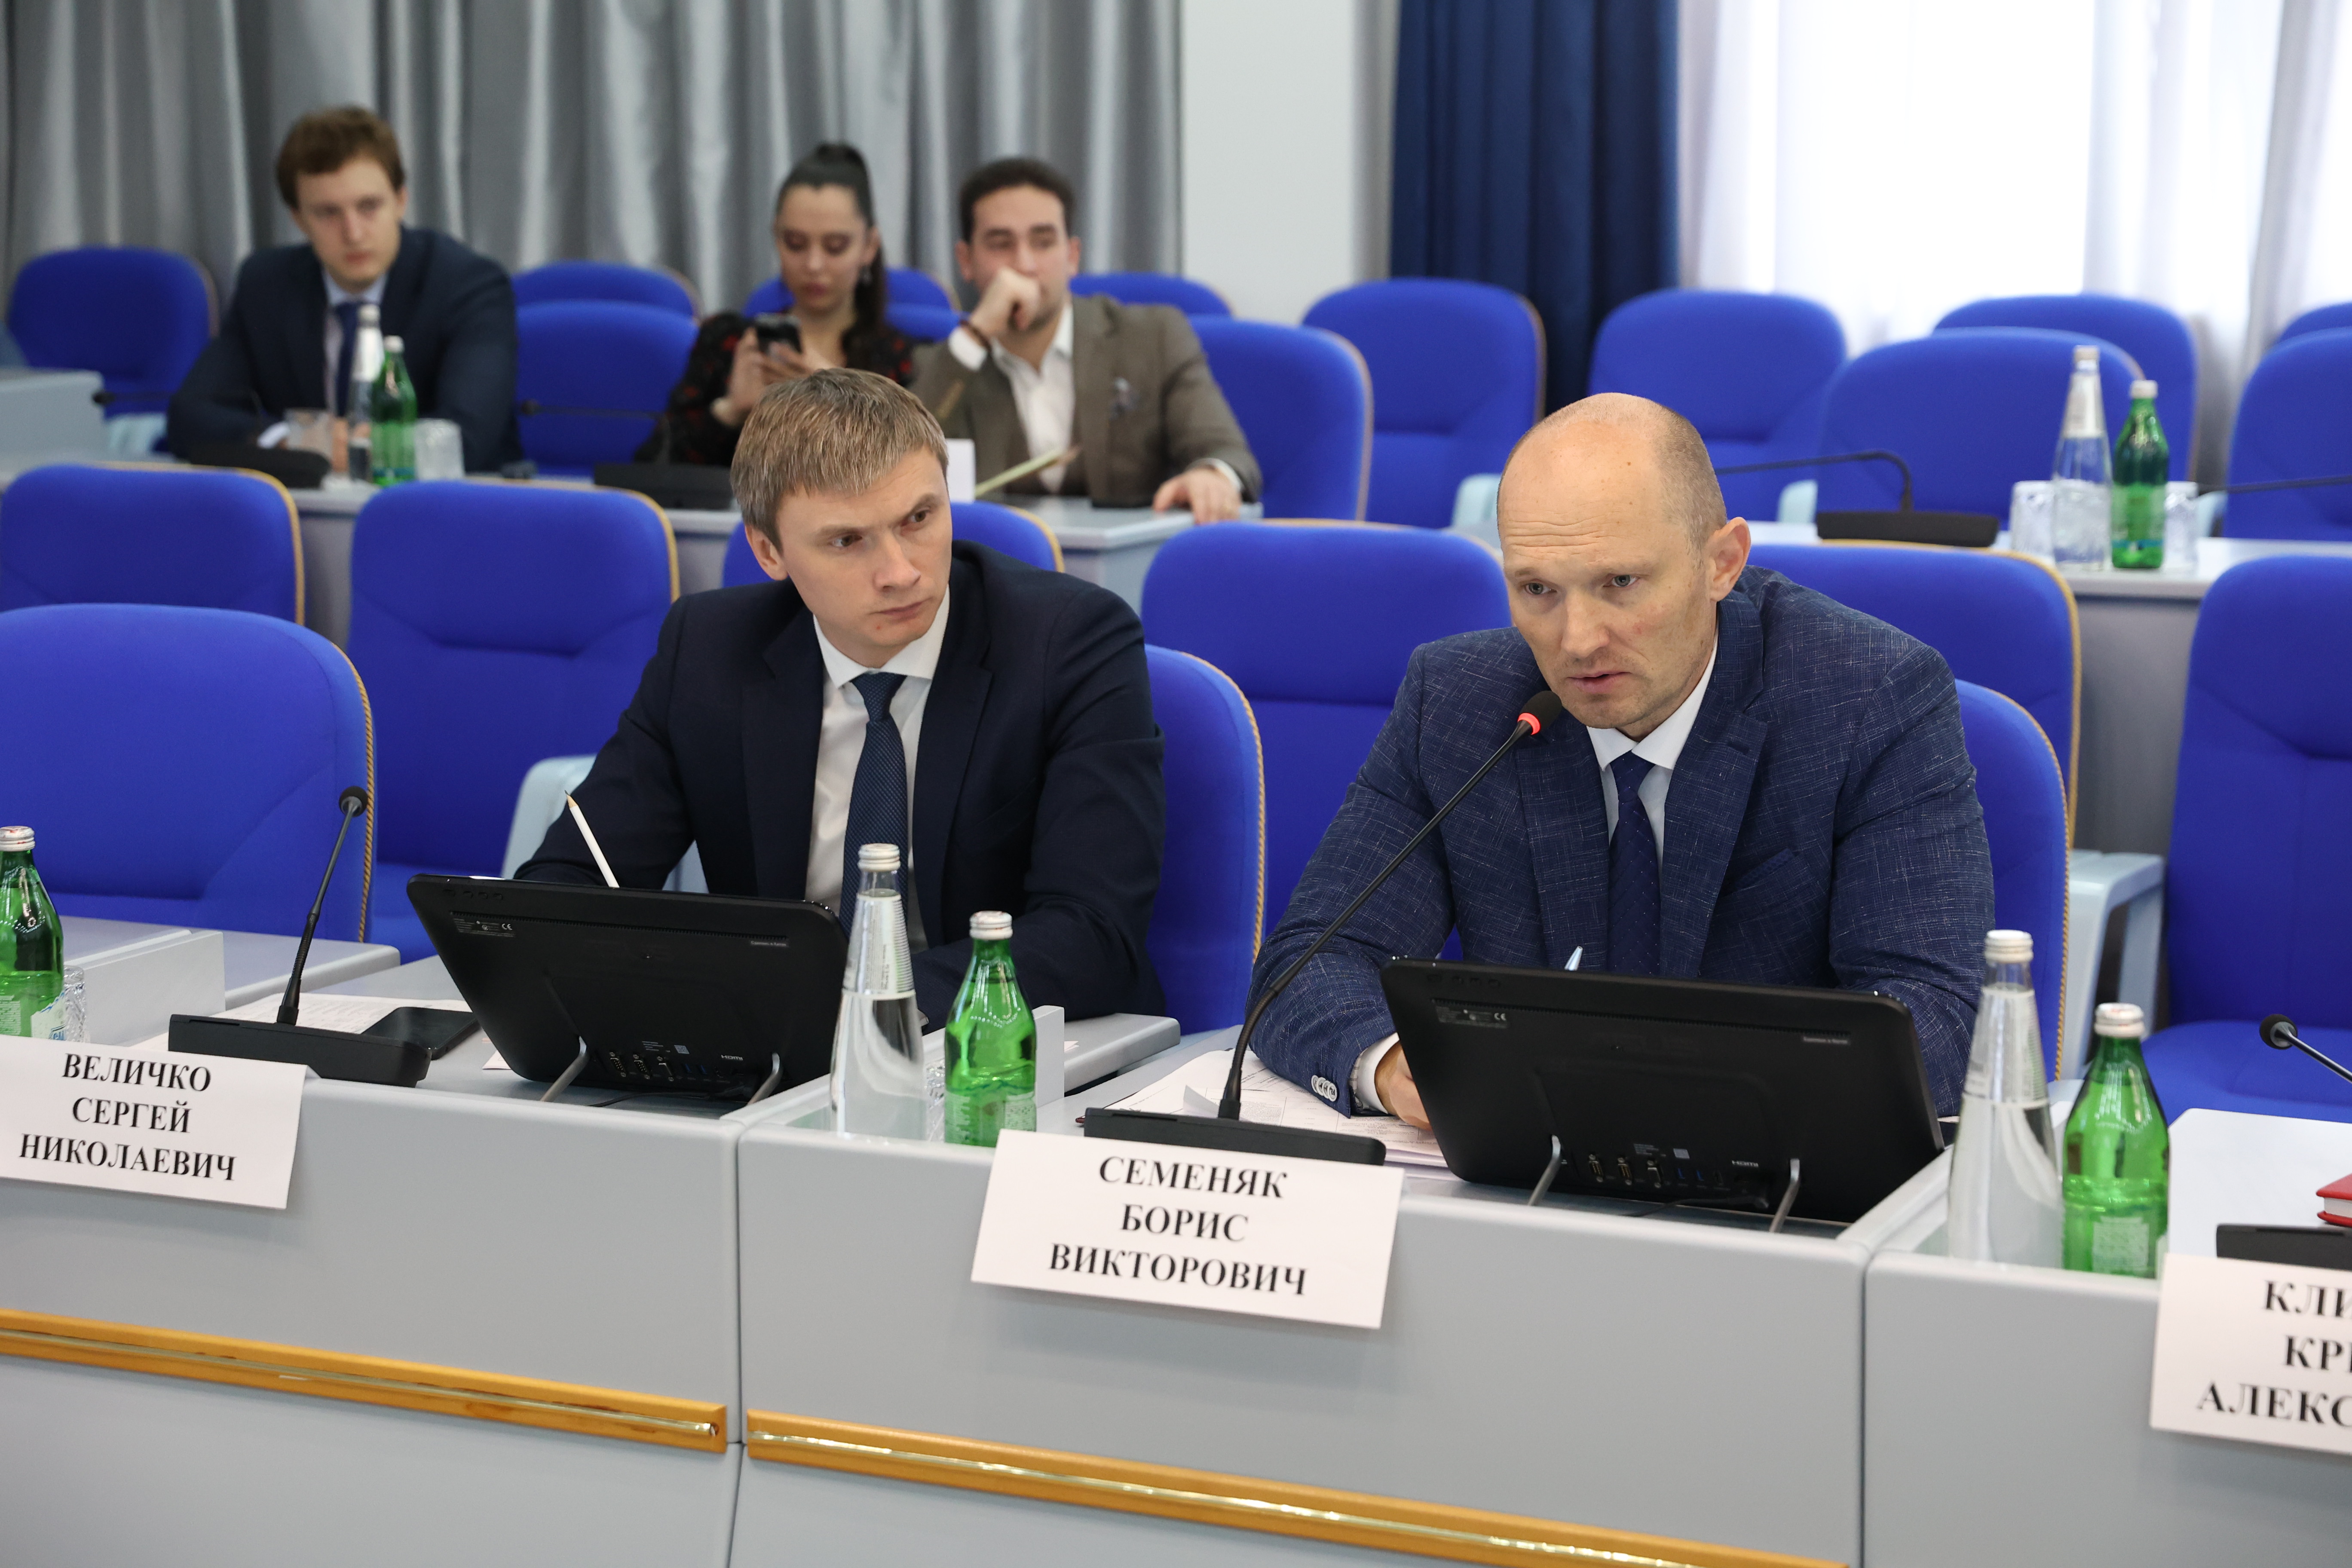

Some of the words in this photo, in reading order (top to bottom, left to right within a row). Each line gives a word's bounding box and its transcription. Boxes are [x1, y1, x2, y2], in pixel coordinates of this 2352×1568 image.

[61, 1053, 211, 1093] ВЕЛИЧКО
[71, 1096, 192, 1133] СЕРГЕЙ
[18, 1133, 236, 1181] НИКОЛАЕВИЧ
[1099, 1156, 1288, 1198] СЕМЕНЯК
[1121, 1204, 1249, 1241] БОРИС
[1049, 1243, 1307, 1295] ВИКТОРОВИЧ
[2284, 1335, 2352, 1373] КР
[2197, 1381, 2352, 1428] АЛЕКС
